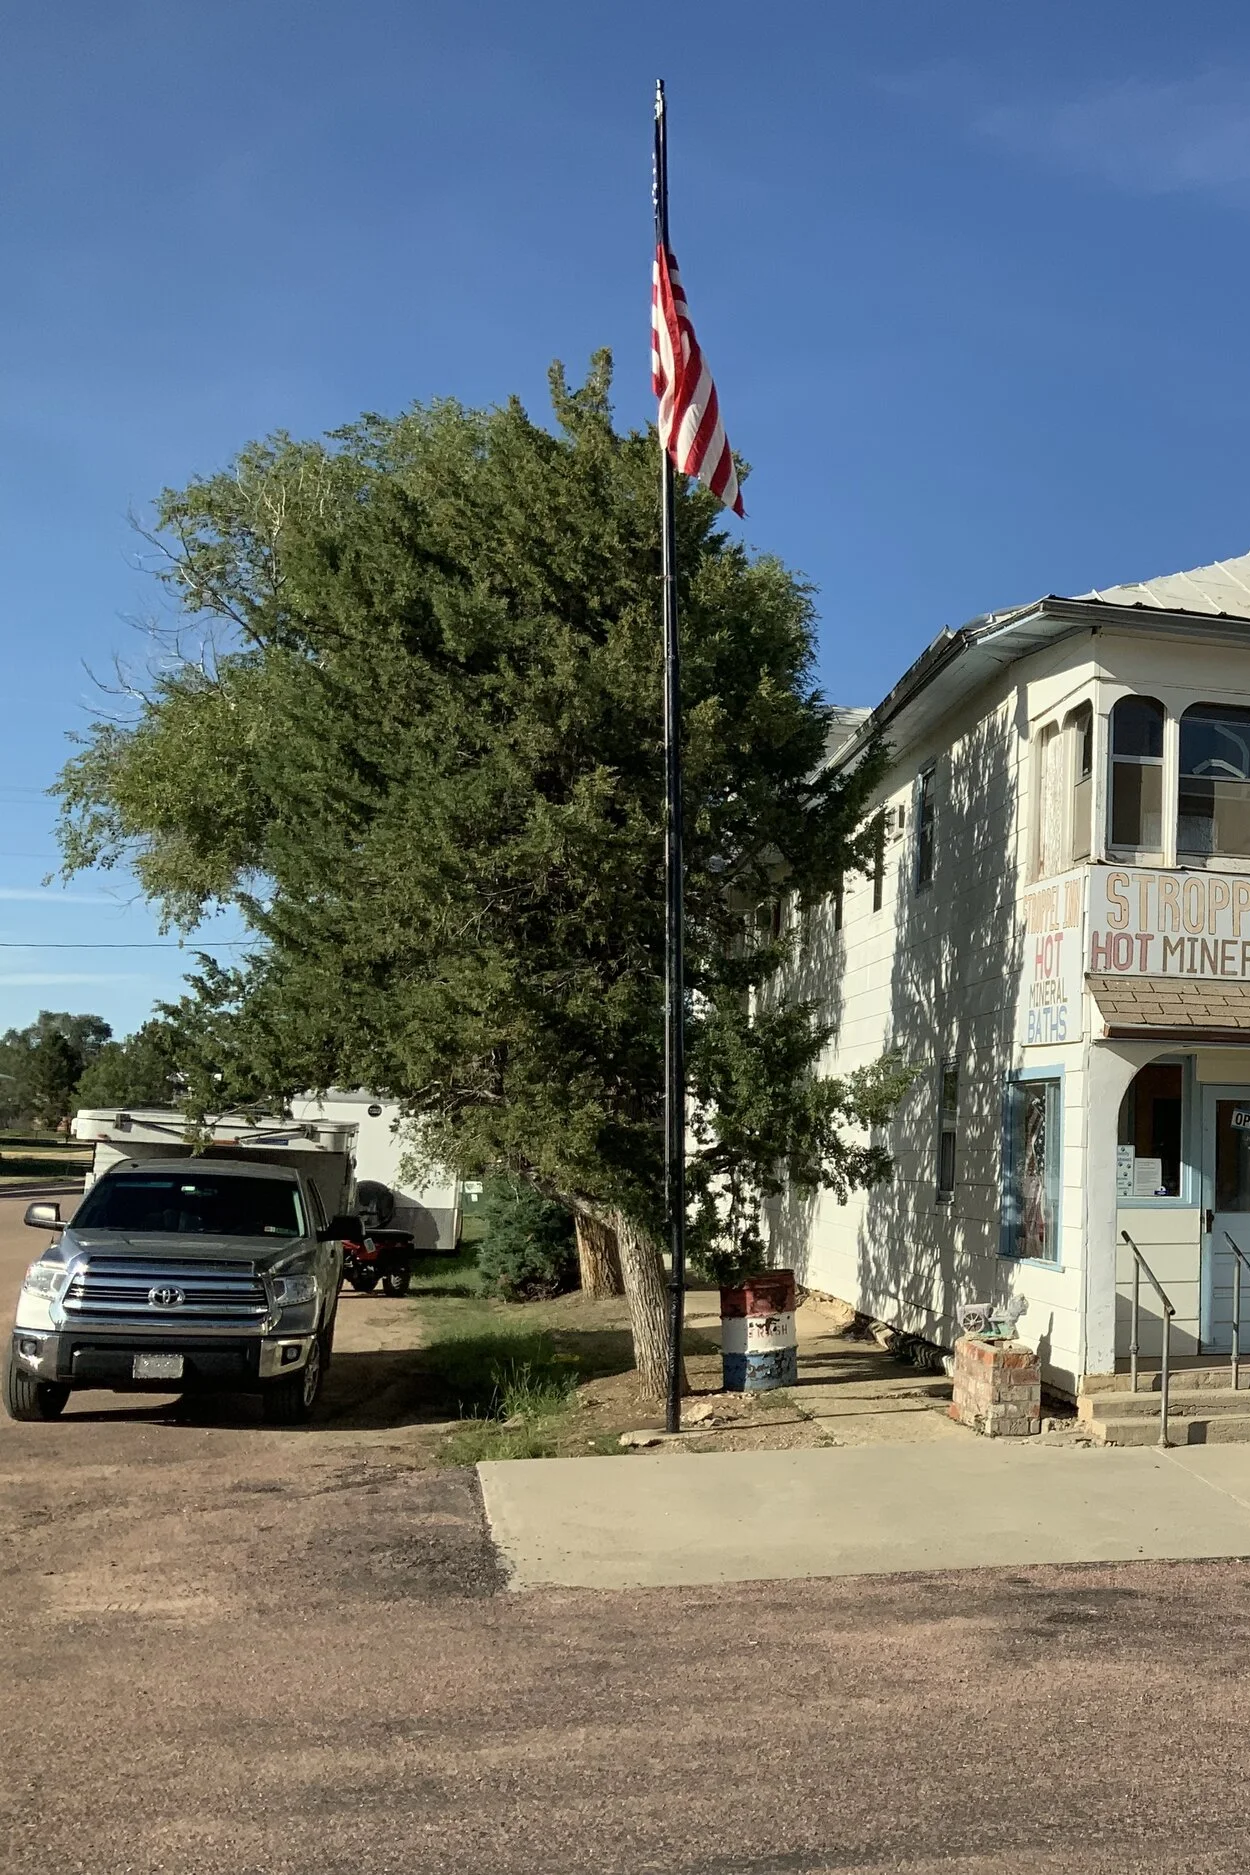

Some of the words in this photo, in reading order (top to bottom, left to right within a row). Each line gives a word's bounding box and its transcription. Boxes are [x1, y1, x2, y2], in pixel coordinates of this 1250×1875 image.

[1022, 885, 1060, 934] STROPPEL
[1062, 878, 1082, 929] INN
[1035, 932, 1064, 981] HOT
[1090, 931, 1154, 972] HOT
[1029, 977, 1068, 1009] MINERAL
[1027, 1005, 1067, 1044] BATHS
